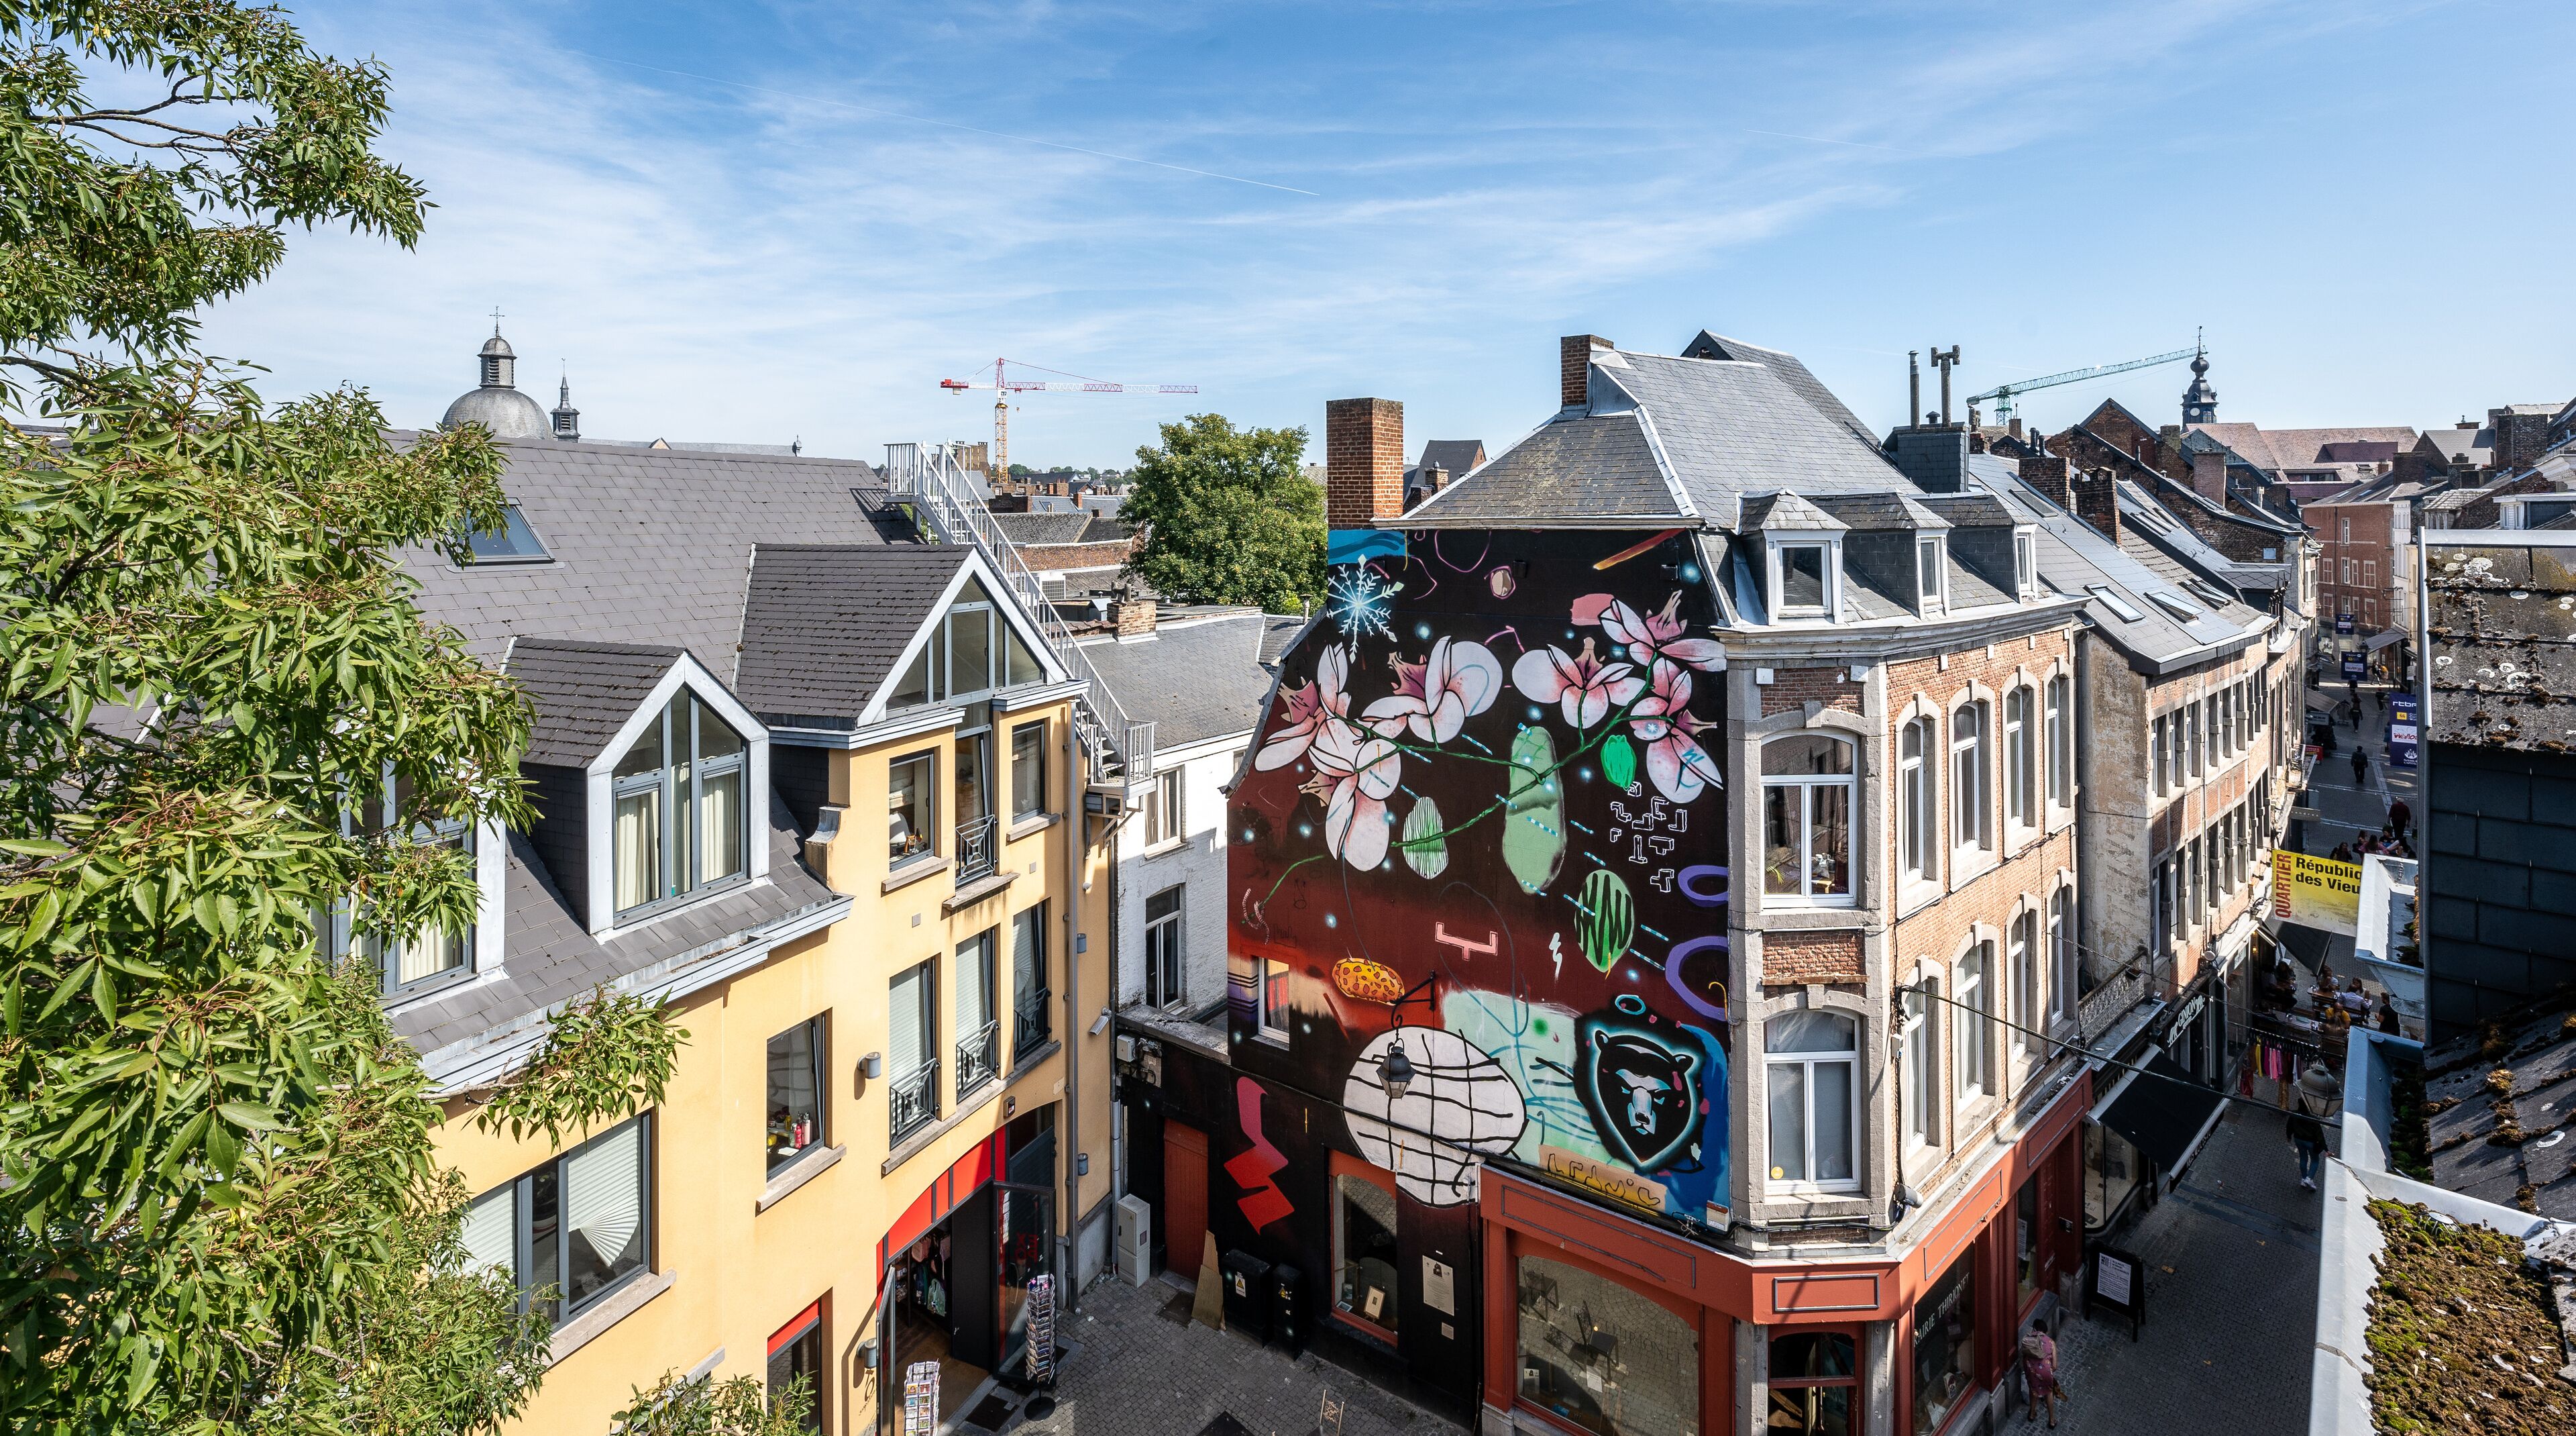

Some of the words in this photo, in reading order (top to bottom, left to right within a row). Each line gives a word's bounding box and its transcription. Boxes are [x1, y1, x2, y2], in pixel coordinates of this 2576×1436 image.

[2275, 854, 2292, 919] QUARTIER
[2296, 872, 2322, 886] des
[2327, 877, 2361, 894] Vieu
[2178, 996, 2196, 1027] GINION
[1937, 1272, 1970, 1319] THIRIONET
